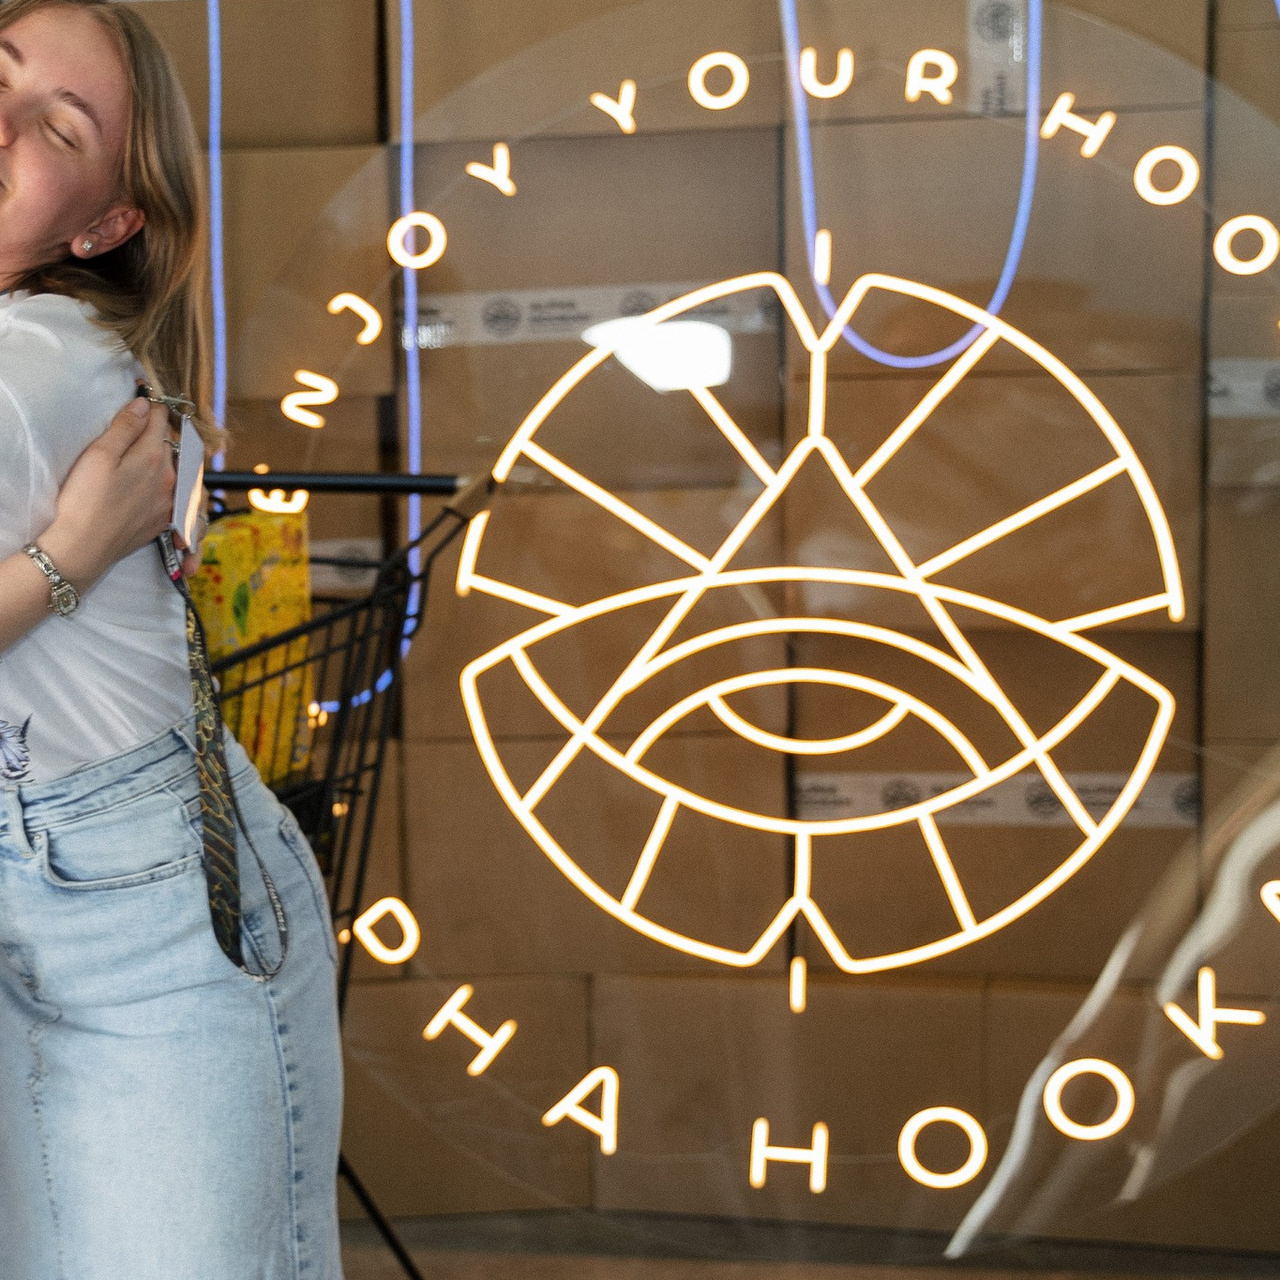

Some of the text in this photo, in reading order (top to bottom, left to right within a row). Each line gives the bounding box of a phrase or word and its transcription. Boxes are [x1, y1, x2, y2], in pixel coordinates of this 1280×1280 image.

[247, 46, 1280, 515] ENJOY YOUR HOO
[748, 879, 1280, 1194] HOOK
